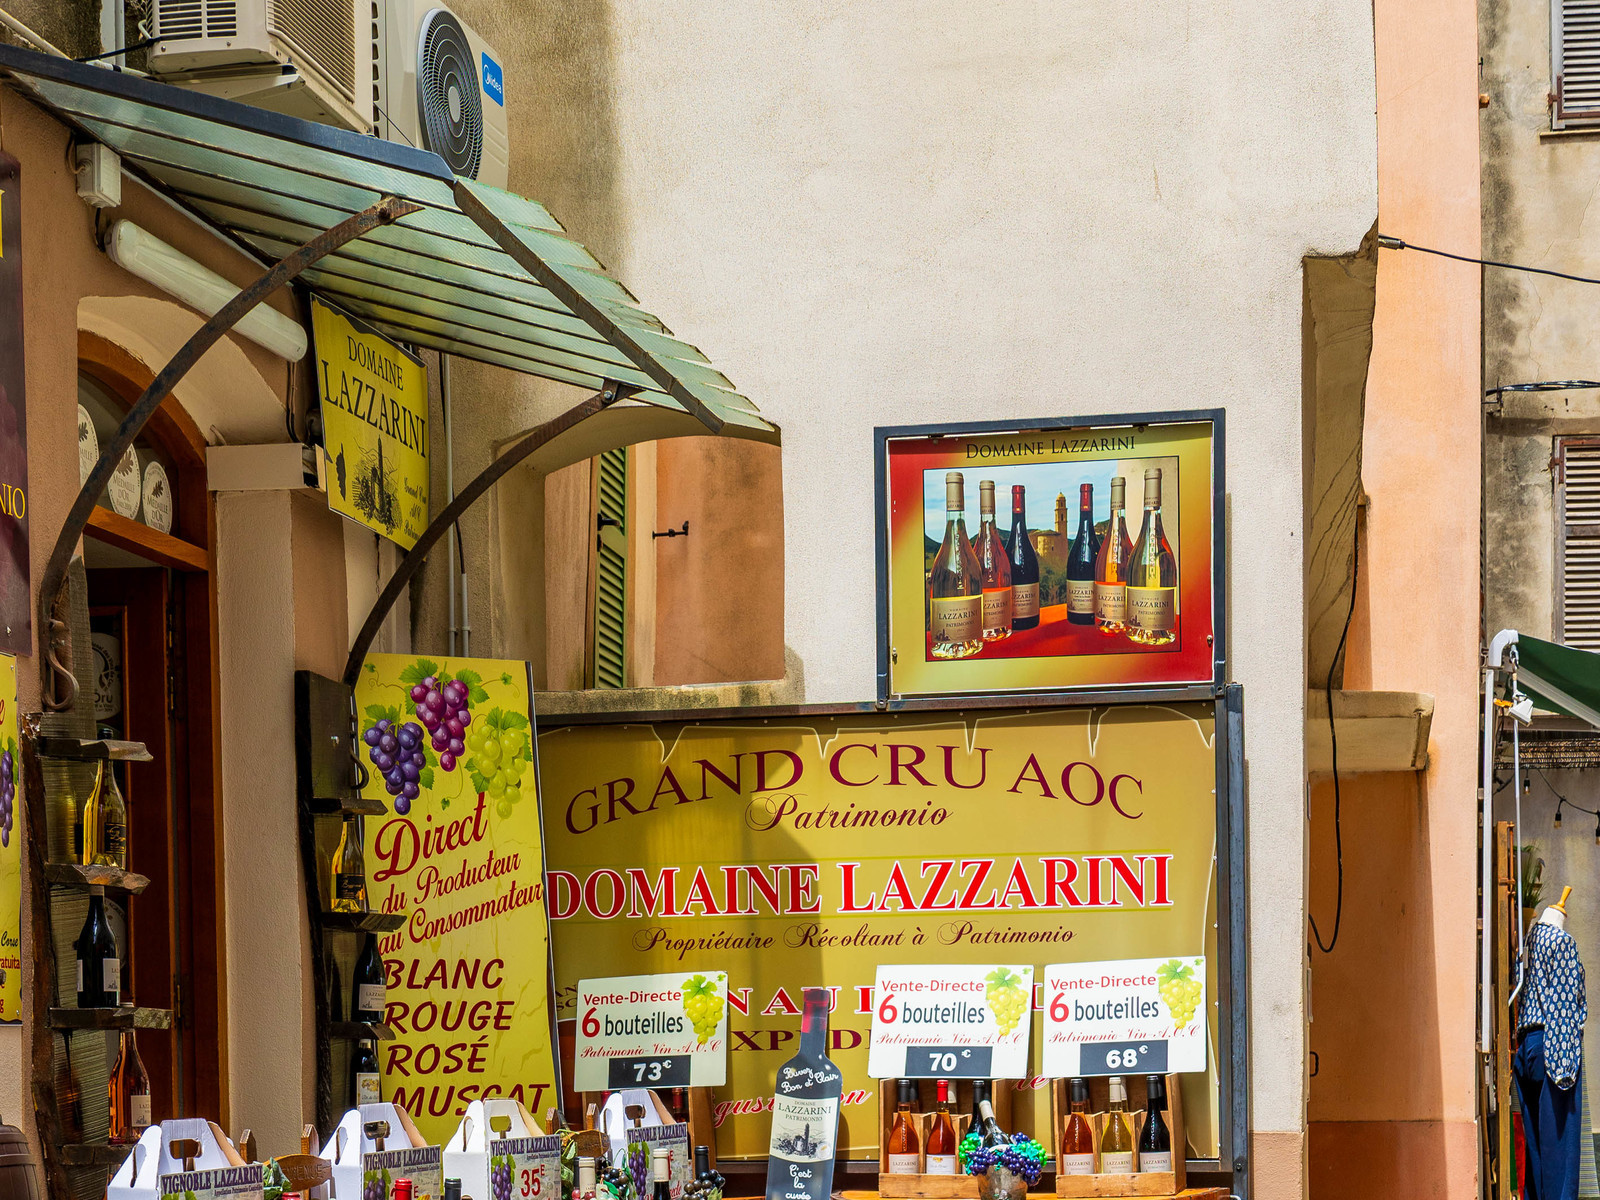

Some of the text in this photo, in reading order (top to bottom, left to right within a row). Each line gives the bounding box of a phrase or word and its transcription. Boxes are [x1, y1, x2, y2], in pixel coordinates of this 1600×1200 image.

[347, 336, 404, 391] DOMAINE
[321, 359, 426, 458] LAZZARINI
[966, 436, 1135, 459] DOMAINE LAZZARINI
[0, 483, 26, 520] NIO
[938, 610, 978, 620] LAZZARINI
[1132, 600, 1169, 608] LAZZARINI
[565, 743, 1144, 835] GRAND CRU AOC
[745, 793, 953, 832] Patrimonio
[374, 792, 488, 882] Direct
[382, 884, 407, 914] du
[414, 850, 521, 905] Producteur
[546, 854, 1174, 920] DOMAINE LAZZARINI
[379, 932, 404, 956] au
[409, 880, 543, 943] Consommateur
[1, 931, 18, 947] Corse
[632, 920, 1077, 960] Propriétaire Récoltant à Patrimonio
[383, 959, 504, 990] BLANC
[882, 980, 984, 992] Vente-Directe
[1051, 975, 1156, 991] Vente-Directe
[584, 990, 682, 1007] Vente-Directe
[879, 994, 898, 1024] 6
[902, 1002, 985, 1024] bouteilles
[1050, 992, 1069, 1022] 6
[1074, 996, 1159, 1021] bouteilles
[385, 1001, 515, 1034] ROUGE
[581, 1007, 683, 1038] 6 bouteilles
[386, 1035, 489, 1077] ROSÉ
[781, 1070, 839, 1094] Bon et Clair
[778, 1103, 831, 1116] LAZZARINI
[785, 1114, 823, 1122] PATRIMONIO
[365, 1151, 401, 1171] VIGNOBLE
[403, 1146, 440, 1167] LAZZARINI
[789, 1164, 812, 1178] C'est
[162, 1164, 263, 1195] VIGNOBLE LAZZARINI
[794, 1177, 805, 1189] la
[785, 1191, 811, 1200] cuvée
